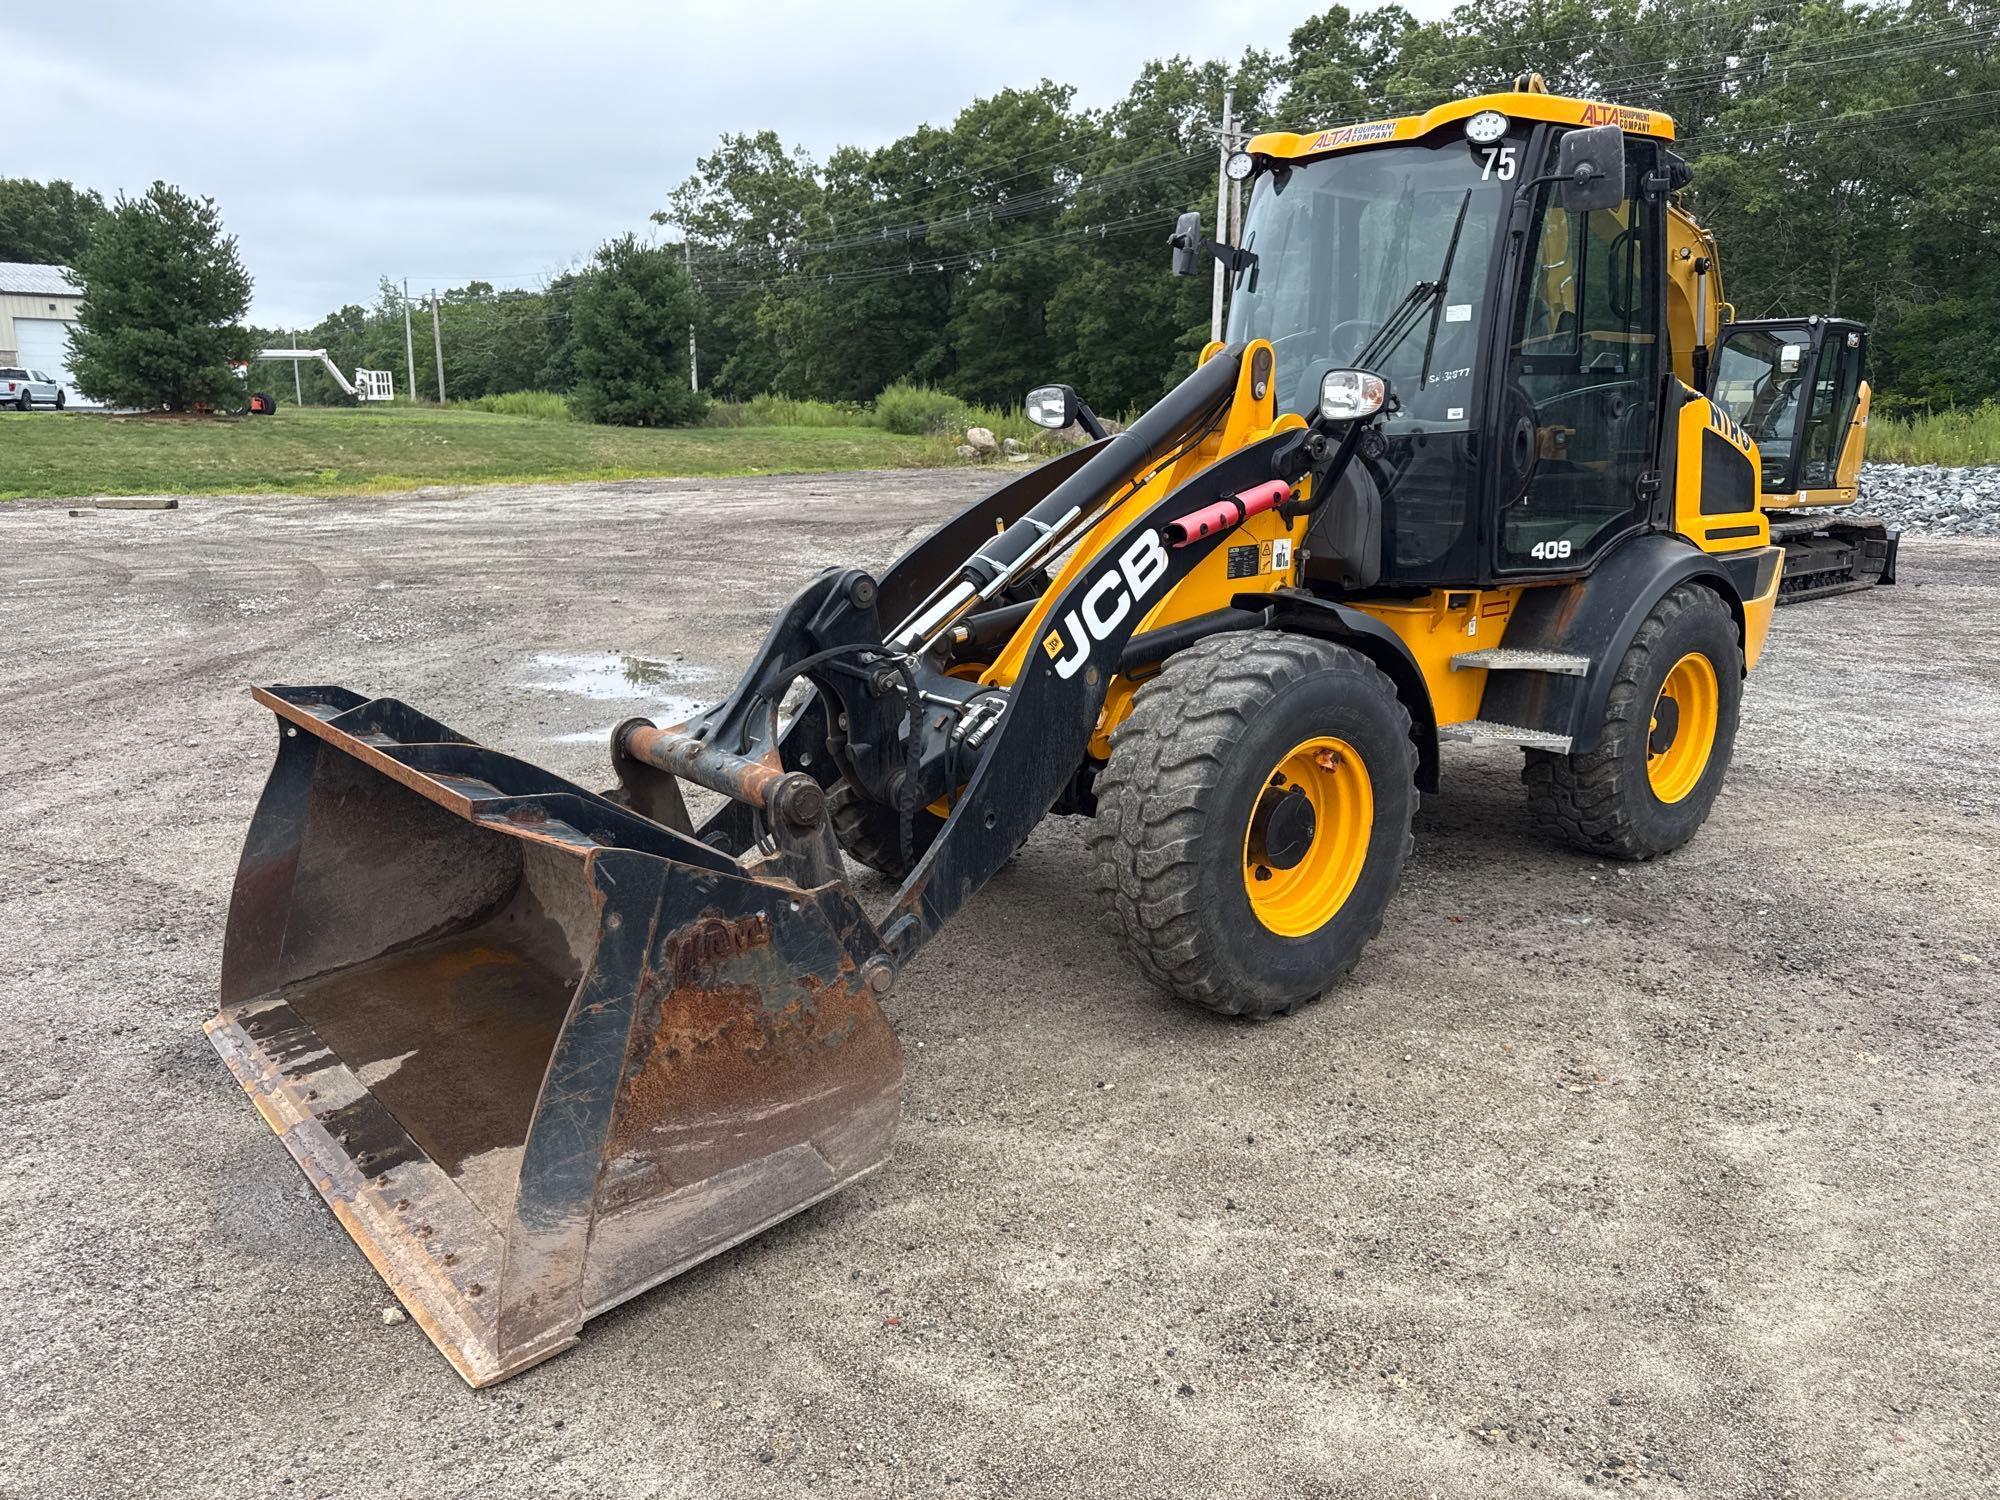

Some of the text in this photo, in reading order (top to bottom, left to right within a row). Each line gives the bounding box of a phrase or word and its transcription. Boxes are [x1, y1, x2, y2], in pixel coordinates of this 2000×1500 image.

[1580, 104, 1619, 125] ALTA
[1619, 109, 1650, 122] EQUIPMENT
[1354, 123, 1396, 134] EQUIPMENT
[1619, 119, 1650, 132] COMPANY
[1309, 128, 1353, 151] ALTA
[1351, 131, 1393, 142] COMPANY
[1481, 147, 1516, 181] 75
[1531, 540, 1571, 560] 409
[1054, 528, 1169, 680] JCB
